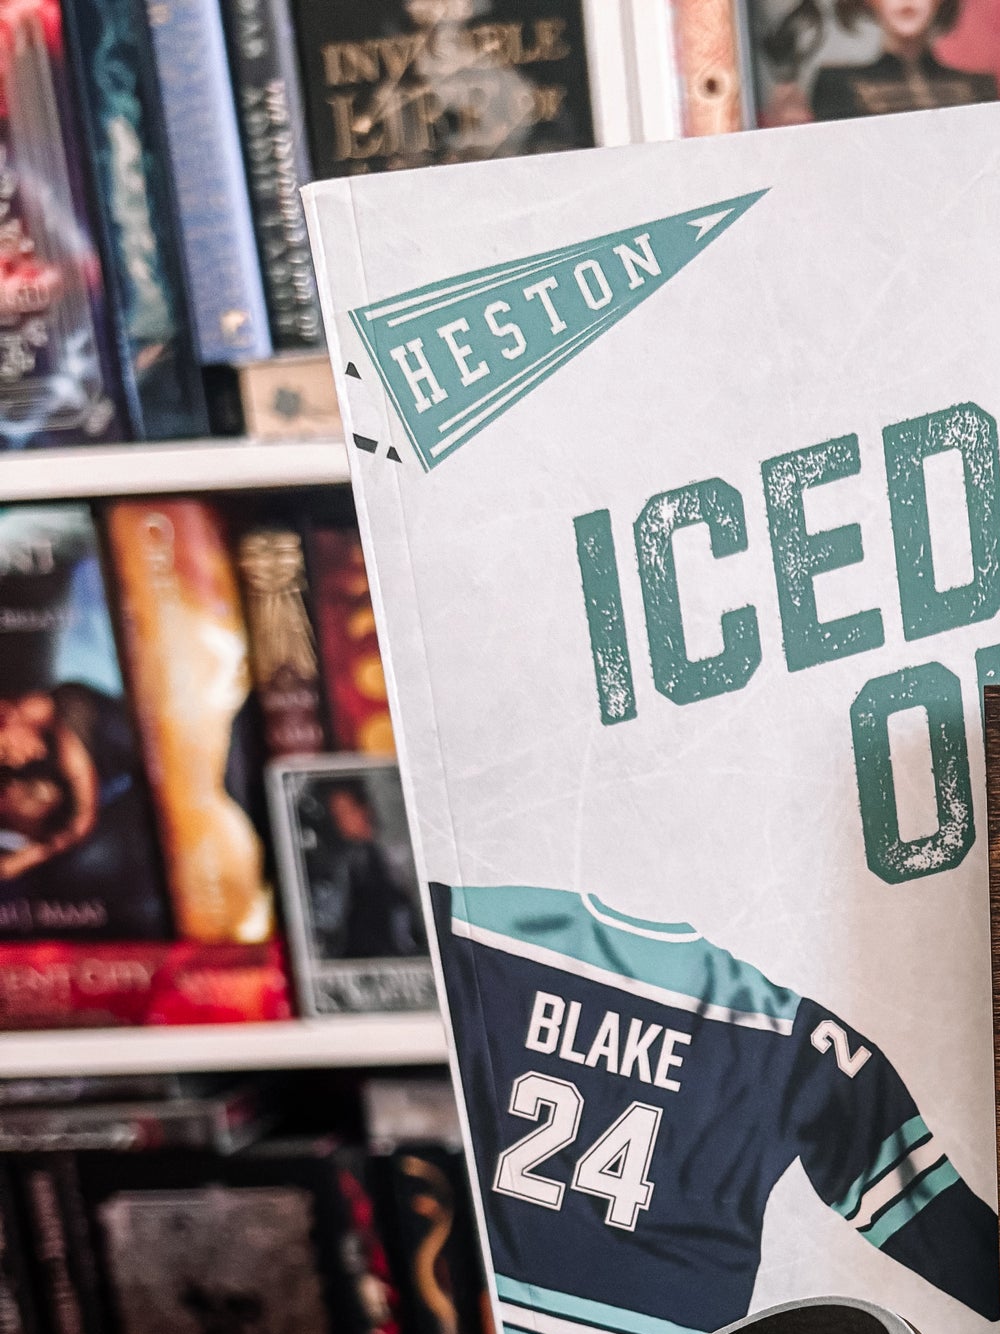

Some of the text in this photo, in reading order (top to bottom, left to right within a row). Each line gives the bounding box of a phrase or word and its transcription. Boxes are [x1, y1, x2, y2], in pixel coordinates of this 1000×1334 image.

[390, 233, 662, 413] HESTON
[525, 990, 692, 1093] BLAKE
[491, 1070, 664, 1233] 24
